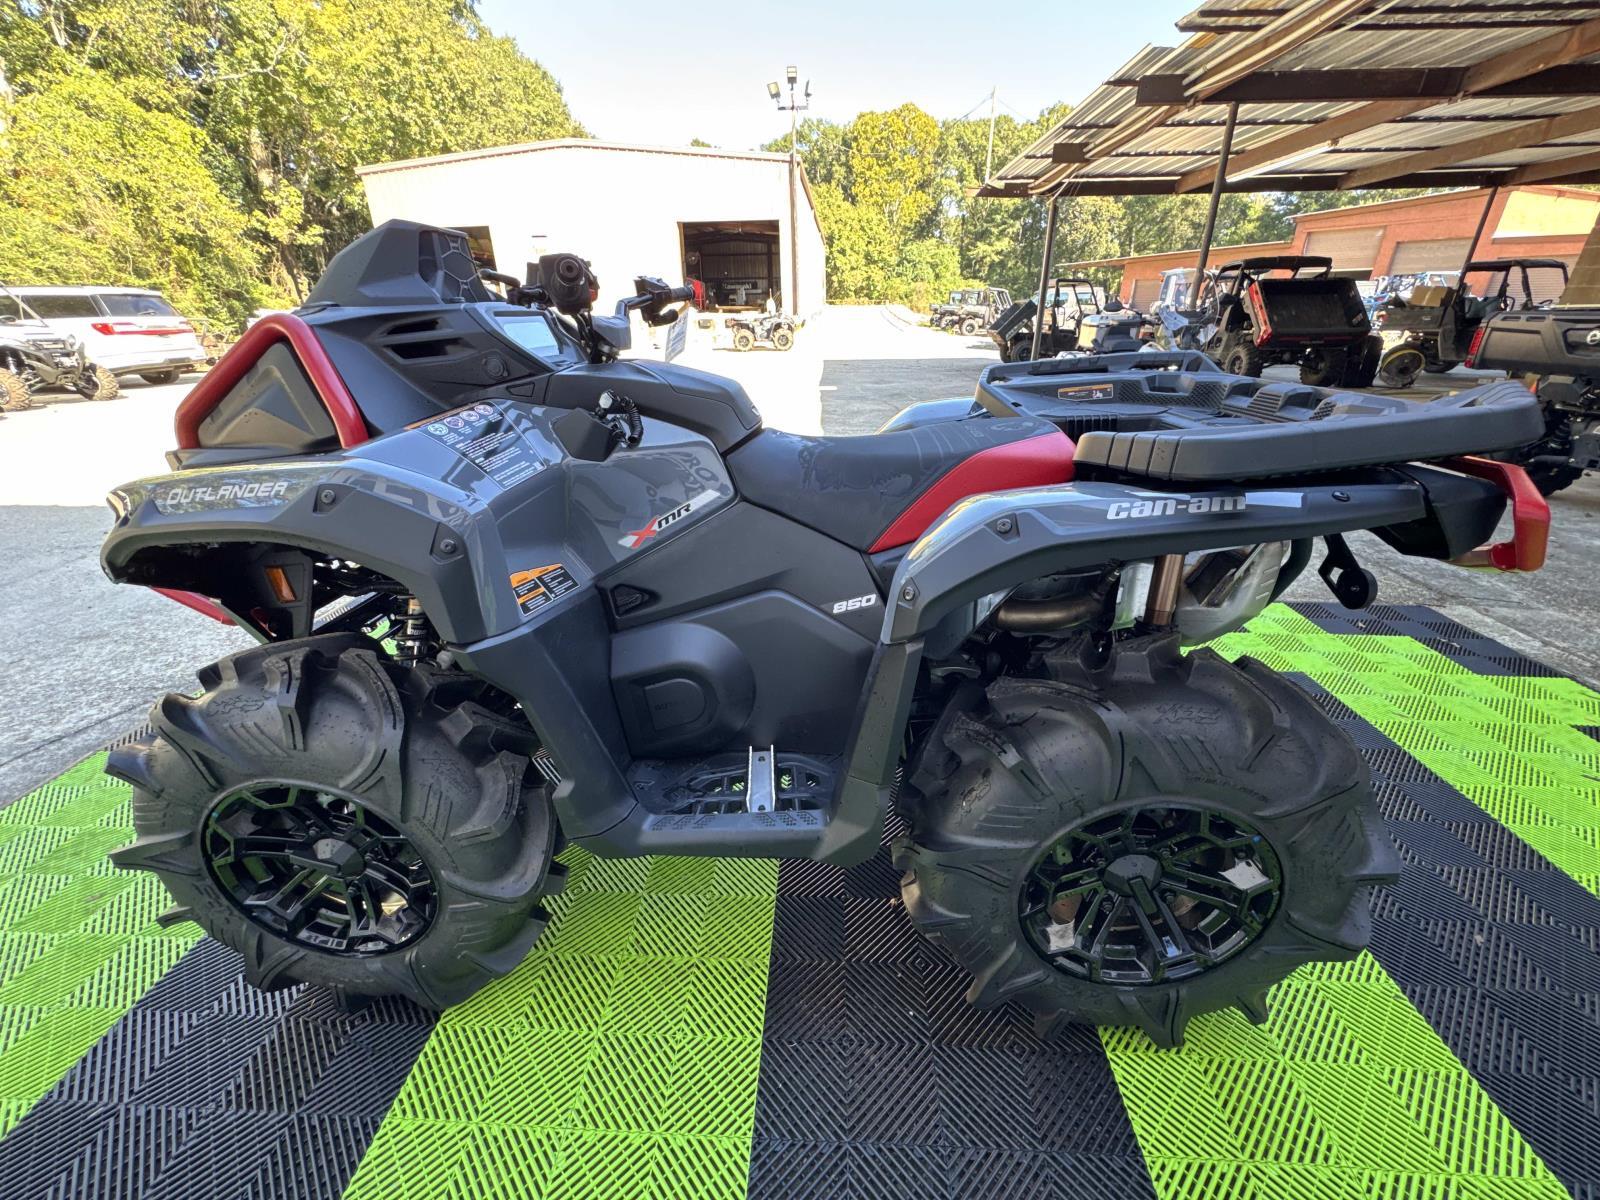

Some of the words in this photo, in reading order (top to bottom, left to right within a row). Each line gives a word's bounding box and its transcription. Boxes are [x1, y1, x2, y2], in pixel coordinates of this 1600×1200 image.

[166, 481, 289, 505] OUTLANDER
[1106, 495, 1246, 520] can-am
[832, 593, 877, 614] 850
